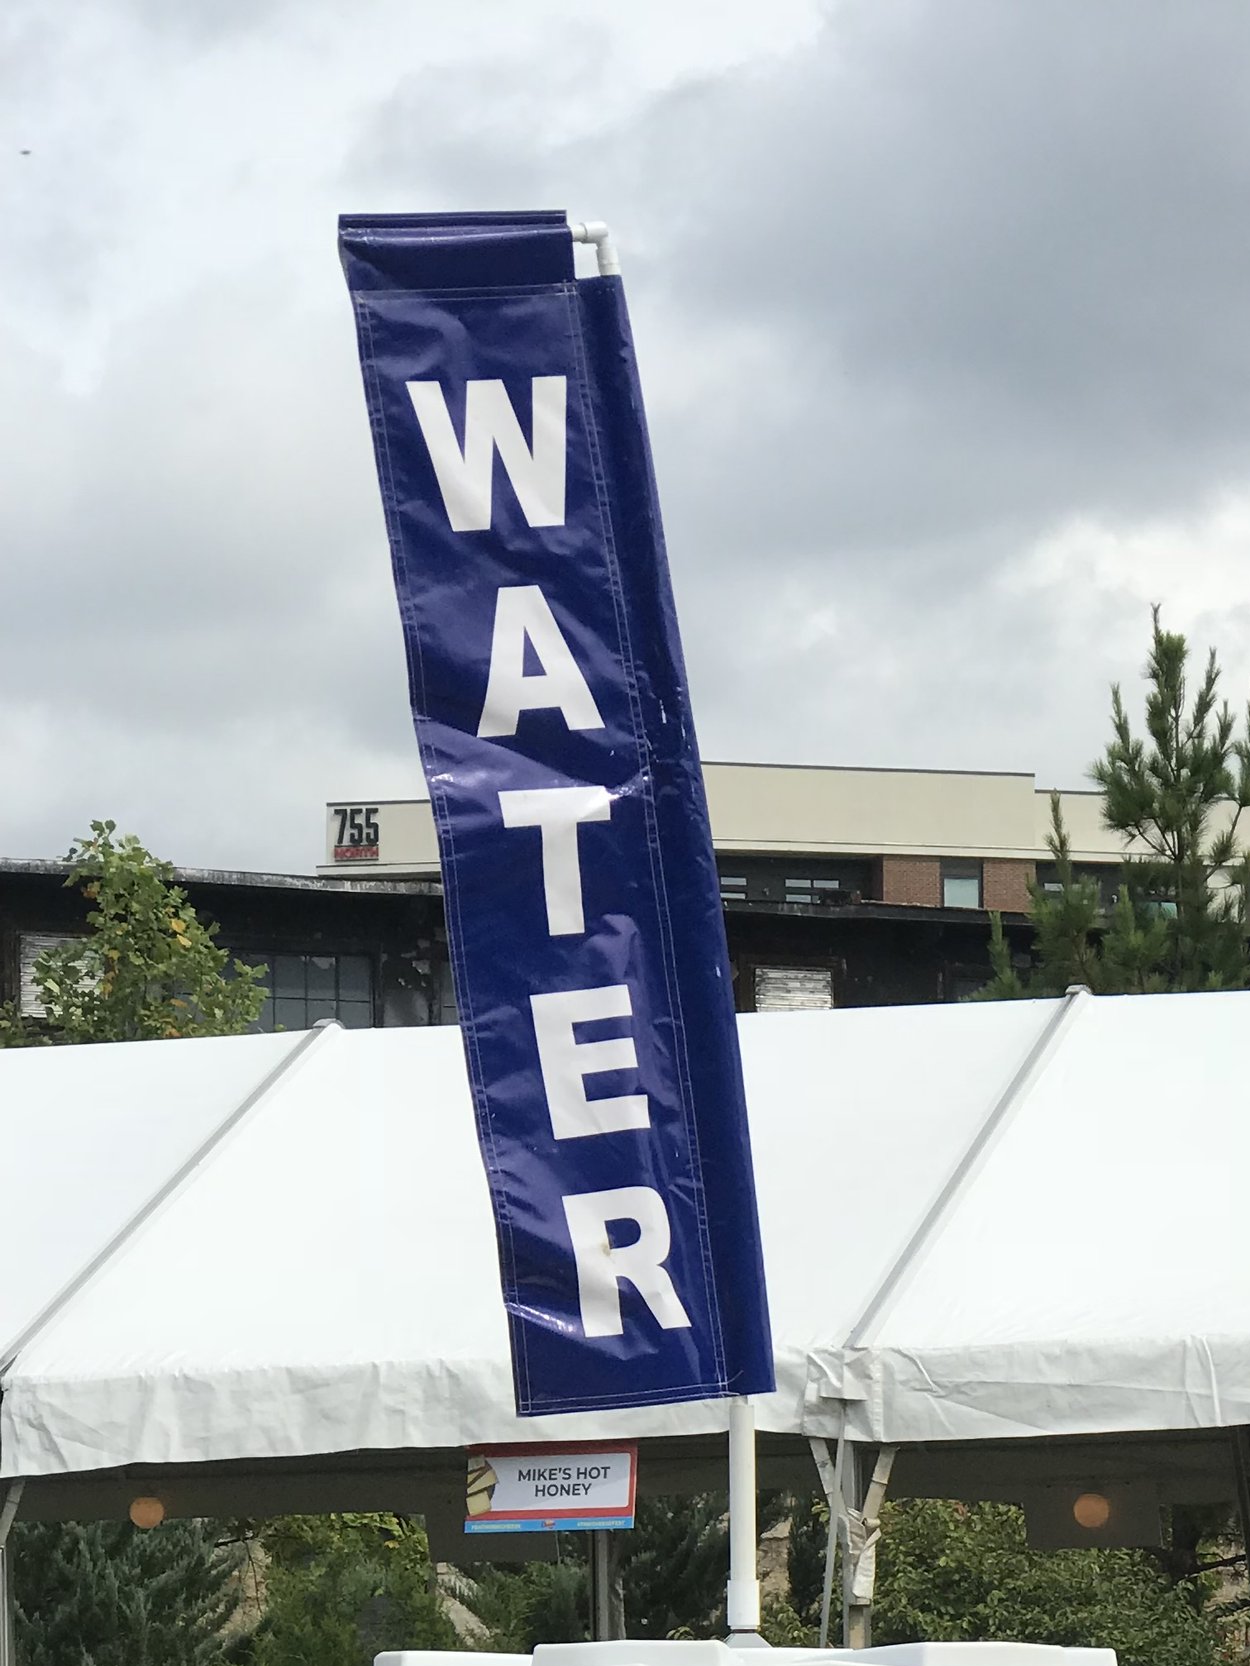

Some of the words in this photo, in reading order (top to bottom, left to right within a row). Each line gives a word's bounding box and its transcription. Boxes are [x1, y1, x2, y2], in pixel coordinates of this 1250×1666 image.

[334, 808, 379, 845] 755
[404, 374, 692, 1341] WATER
[518, 1467, 572, 1482] MIKE'S
[576, 1466, 611, 1480] HOT
[534, 1483, 592, 1497] HONEY
